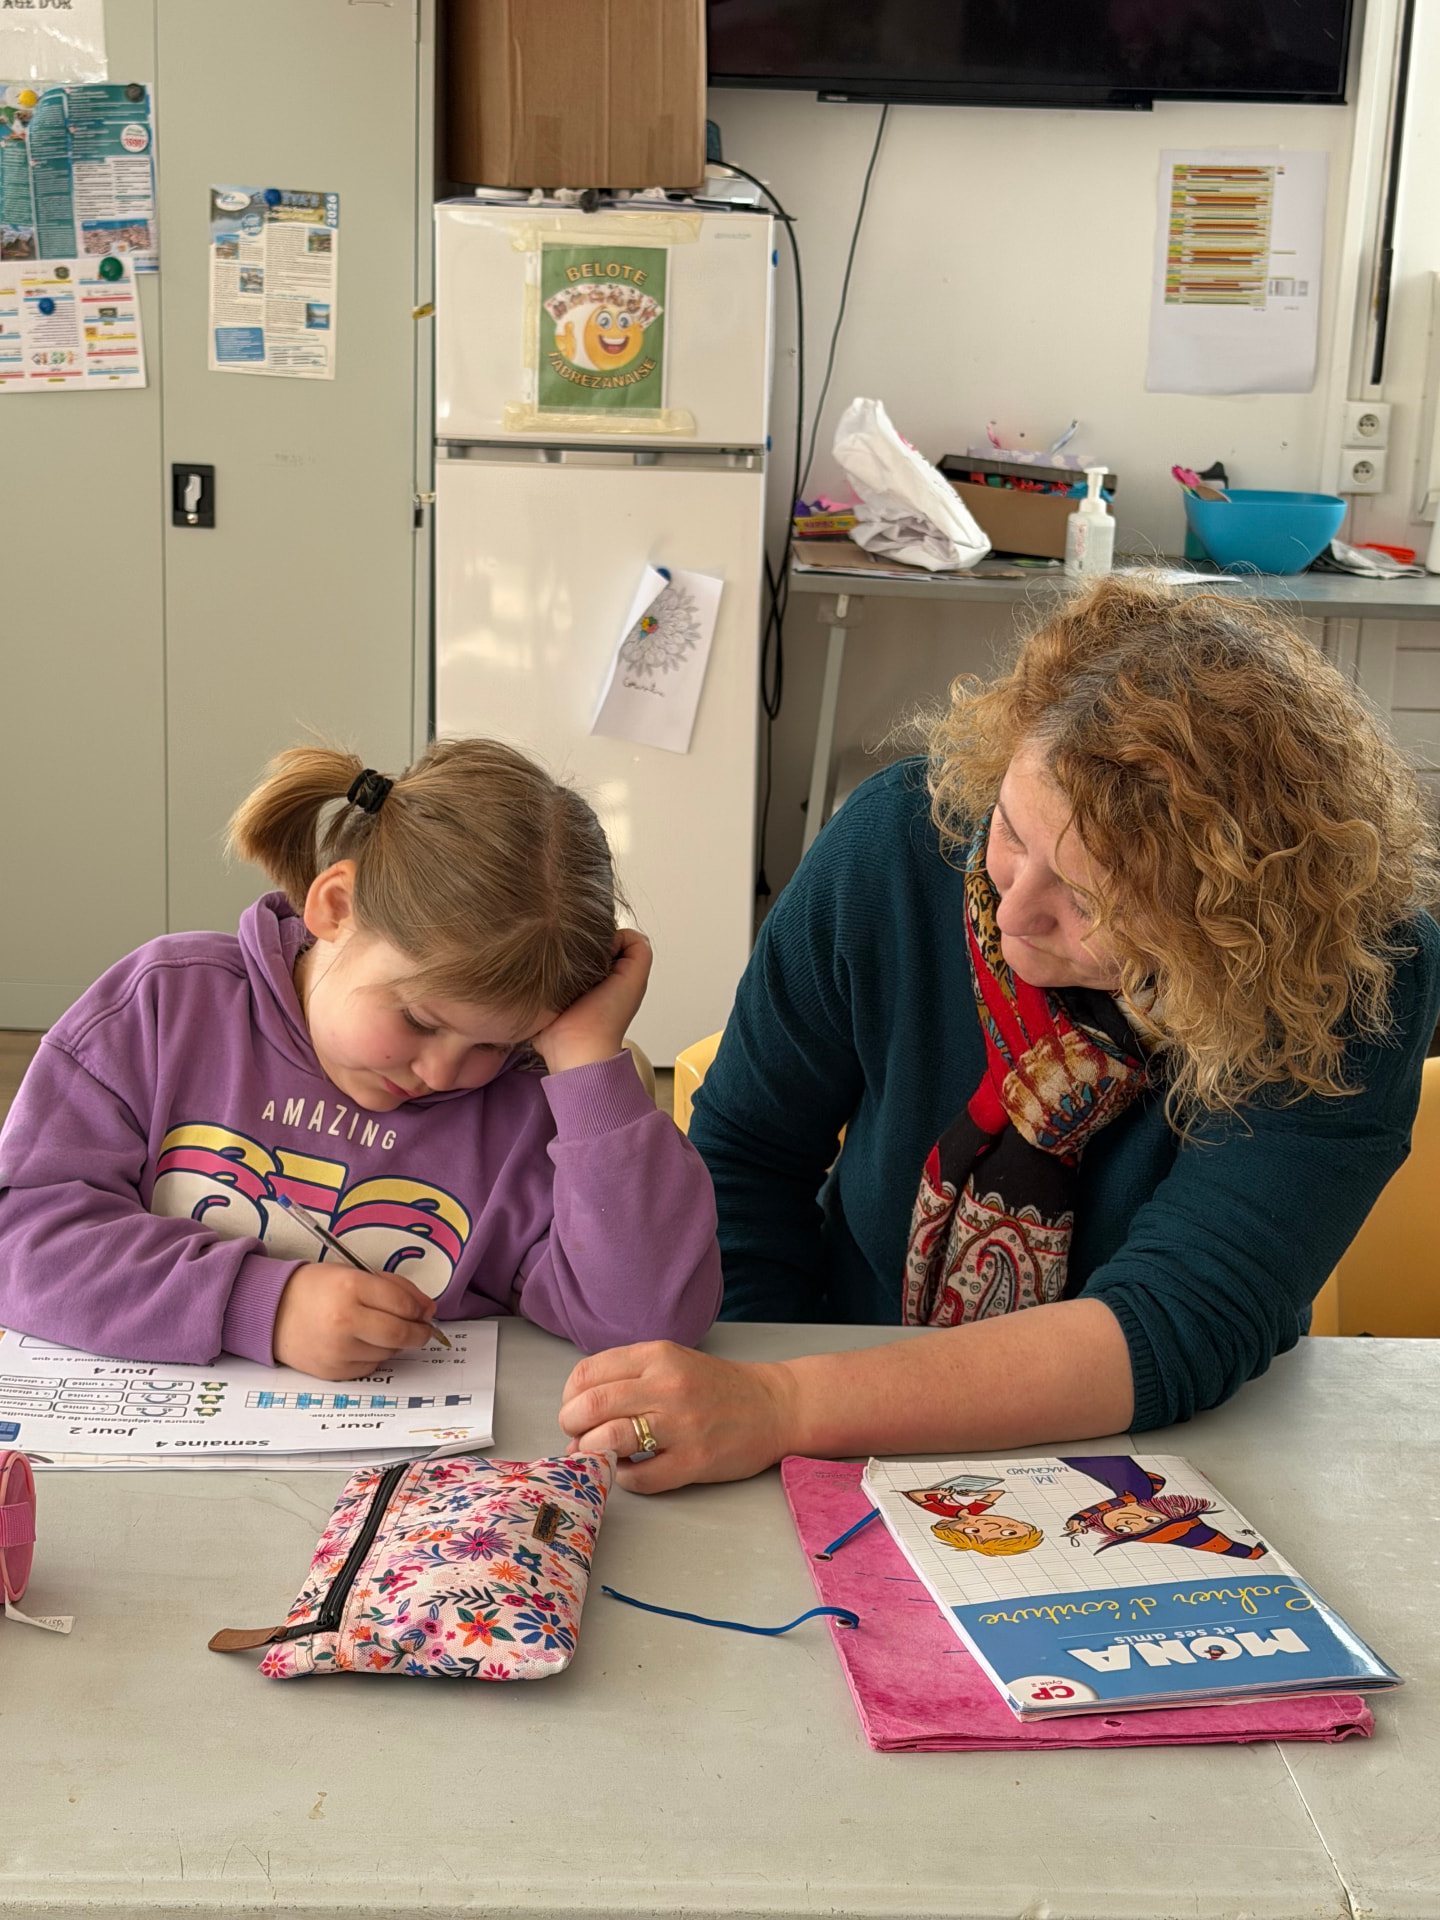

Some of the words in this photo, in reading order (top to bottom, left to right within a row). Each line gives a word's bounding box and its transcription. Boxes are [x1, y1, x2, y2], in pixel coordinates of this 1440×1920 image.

[565, 263, 648, 287] BELOTE
[261, 1098, 397, 1150] AMAZING
[92, 1367, 106, 1375] 4
[109, 1367, 158, 1376] Jour
[337, 1422, 384, 1430] Jour
[69, 1427, 83, 1436] 2
[87, 1427, 138, 1437] Jour
[154, 1440, 169, 1448] 4
[174, 1440, 270, 1448] Semaine
[1006, 1466, 1070, 1474] MAGNARD
[1172, 1585, 1330, 1615] Cahier
[978, 1597, 1157, 1625] d'écriture
[1174, 1629, 1207, 1640] ses
[1212, 1626, 1236, 1635] et
[1113, 1632, 1167, 1647] amis
[1066, 1627, 1311, 1673] MONA
[1031, 1685, 1075, 1701] CP
